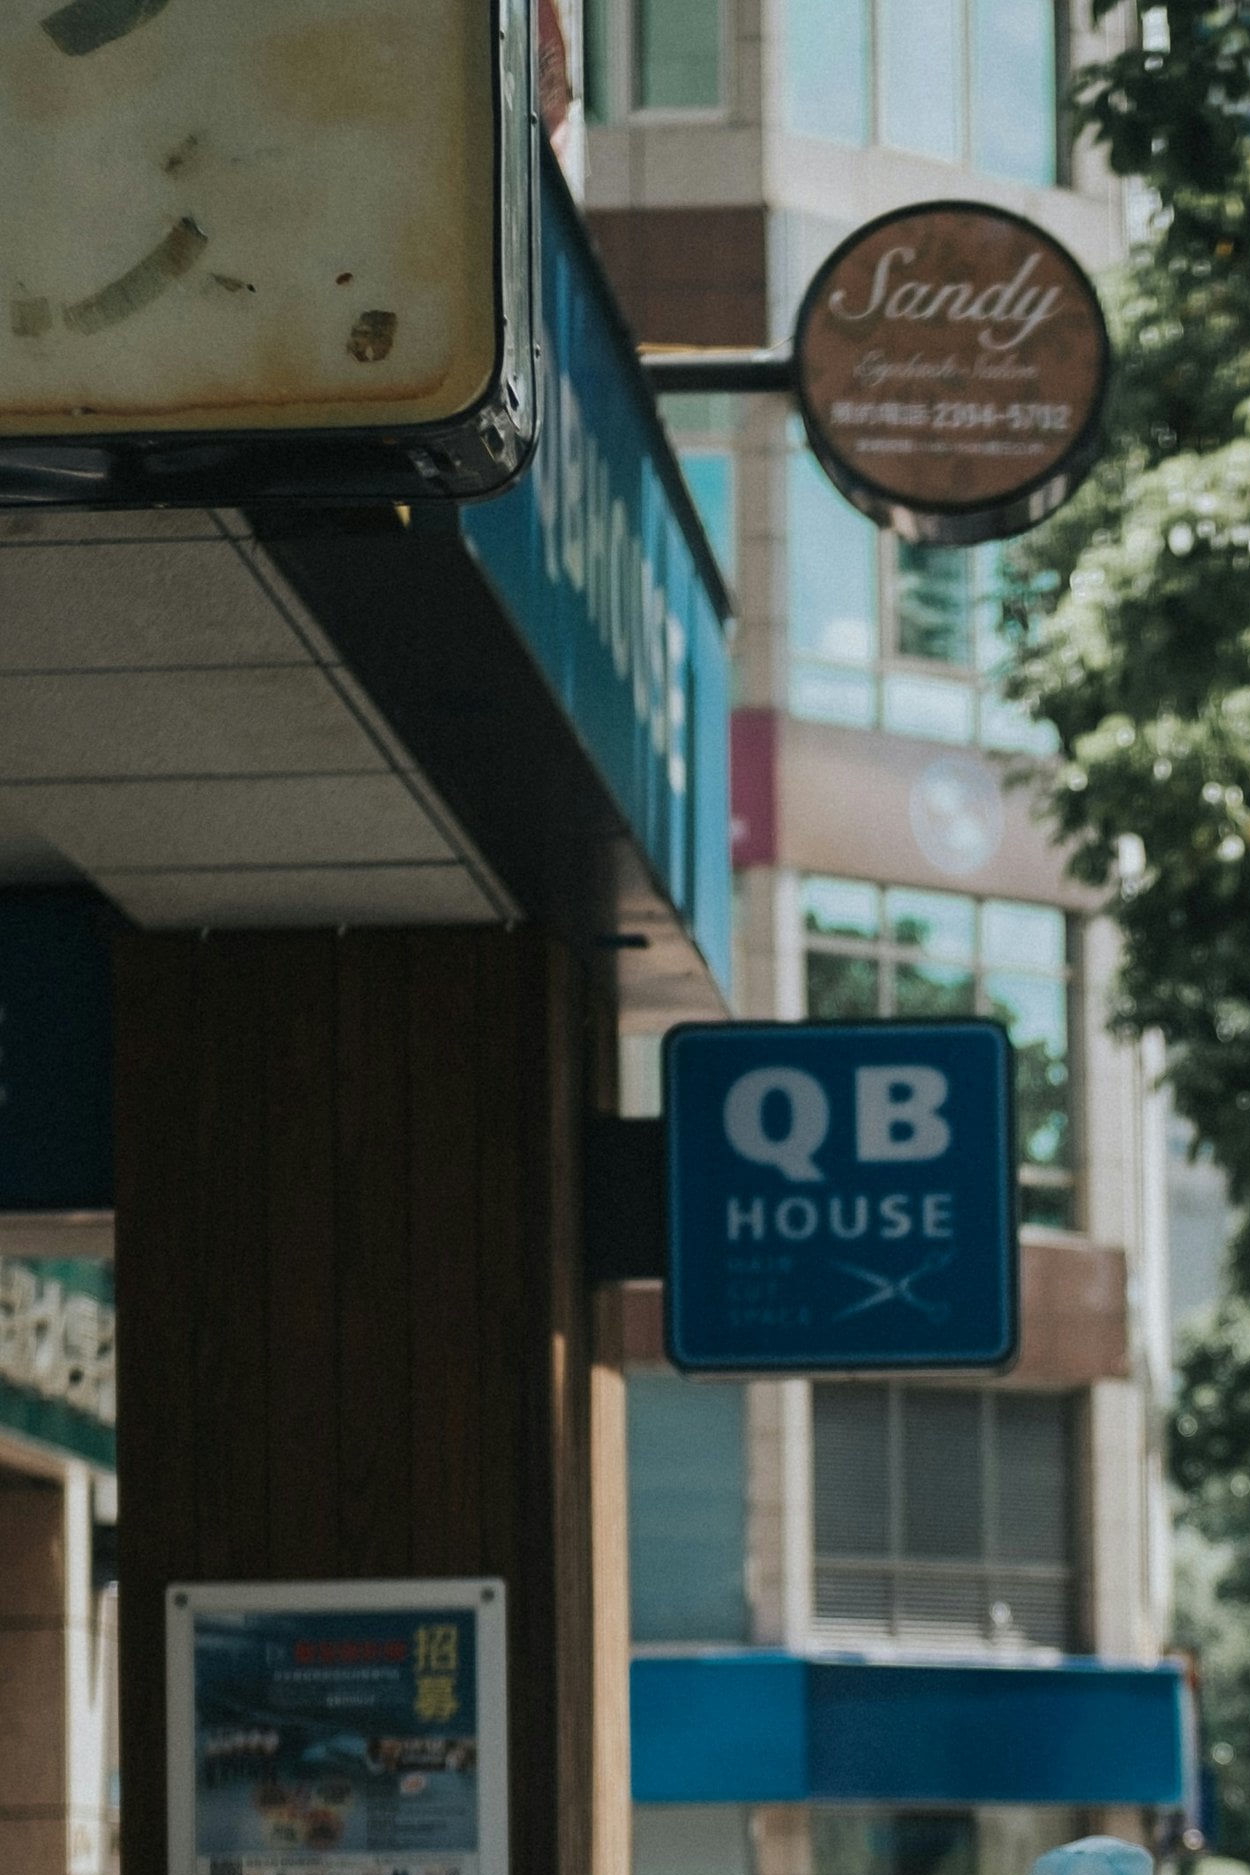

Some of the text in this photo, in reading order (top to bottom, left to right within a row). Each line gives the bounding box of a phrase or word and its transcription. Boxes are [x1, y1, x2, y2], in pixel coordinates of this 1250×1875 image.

[828, 247, 1067, 351] Sandy
[723, 1065, 951, 1182] QB
[727, 1194, 953, 1240] HOUSE
